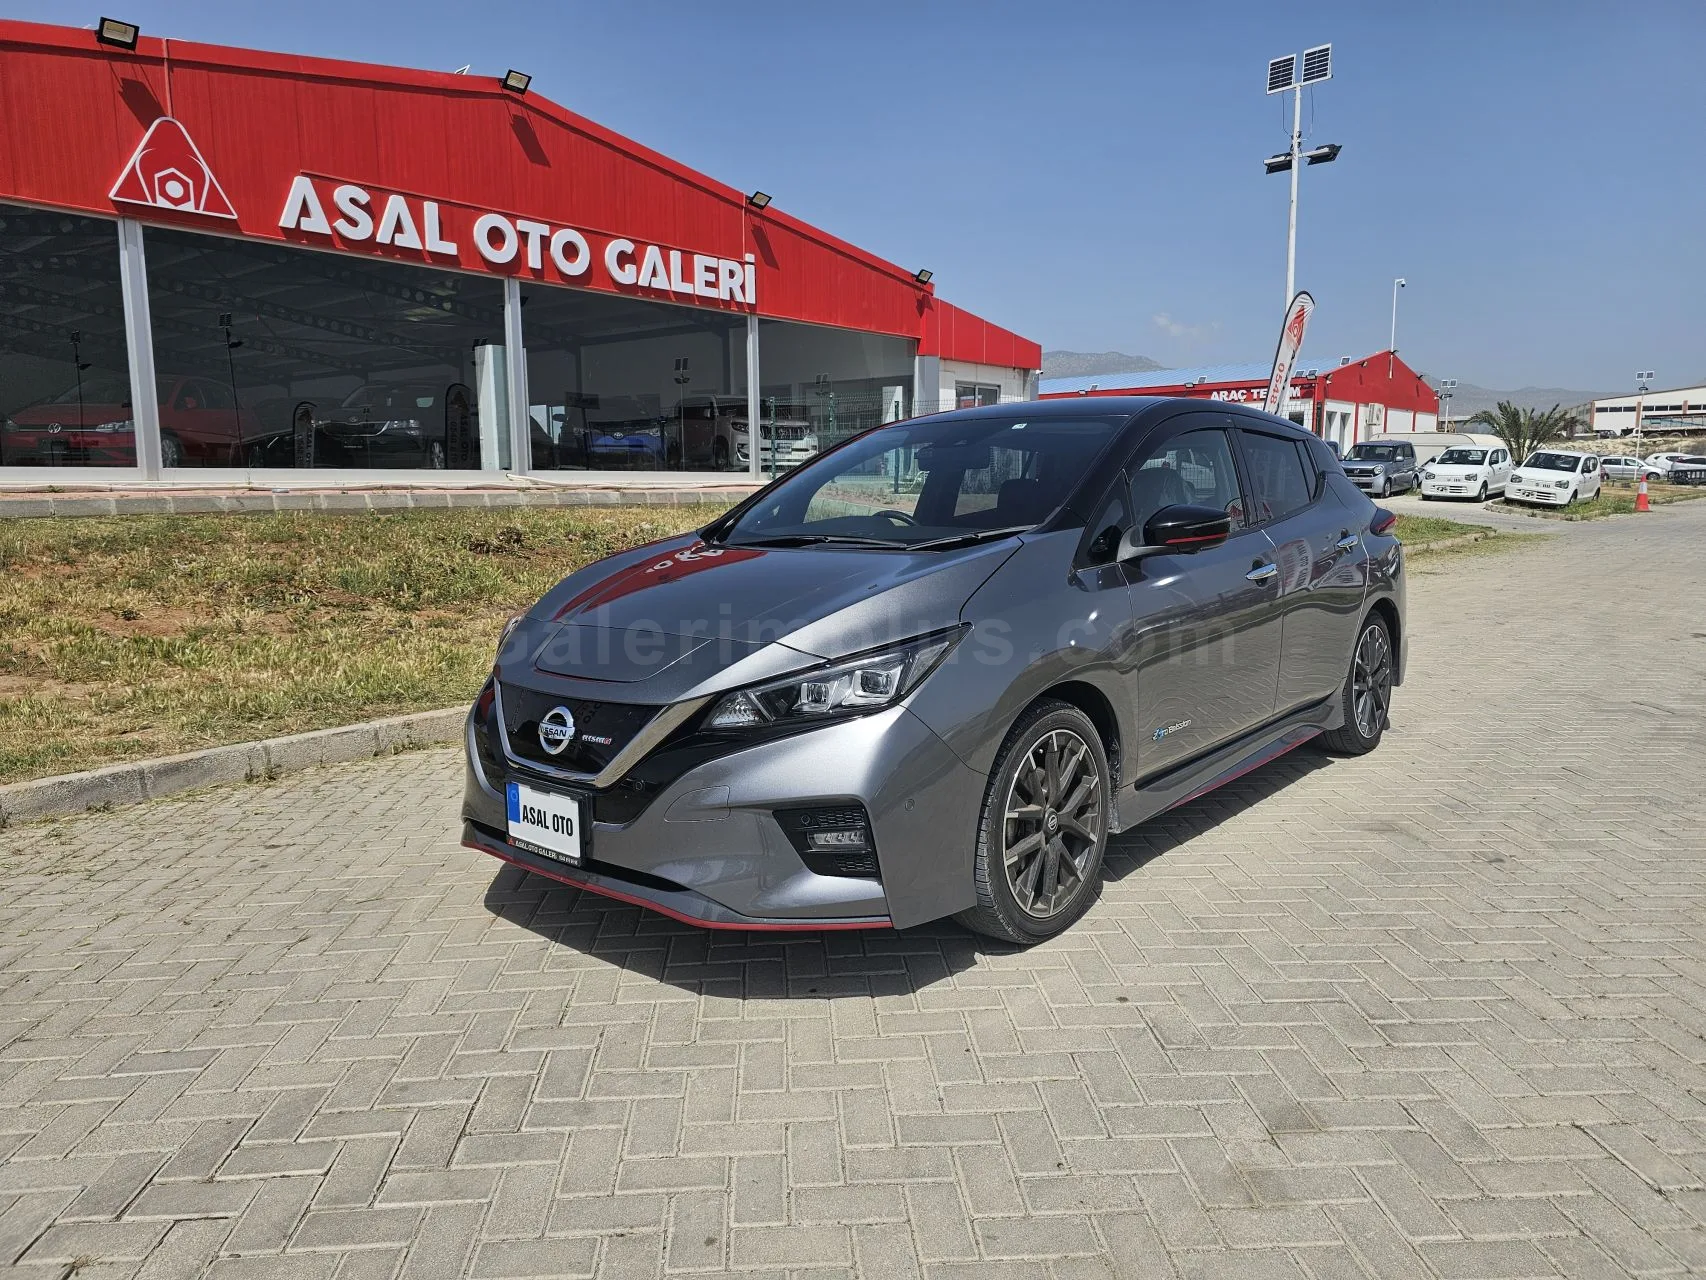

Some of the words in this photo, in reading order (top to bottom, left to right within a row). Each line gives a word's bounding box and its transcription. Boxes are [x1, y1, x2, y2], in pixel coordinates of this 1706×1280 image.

[278, 175, 457, 255] ASAL
[473, 213, 591, 276] OTO
[604, 238, 756, 304] GALERİ
[1210, 389, 1247, 402] ARAÇ
[1270, 362, 1285, 405] 0548
[522, 805, 549, 830] ASAL
[552, 813, 574, 837] OTO
